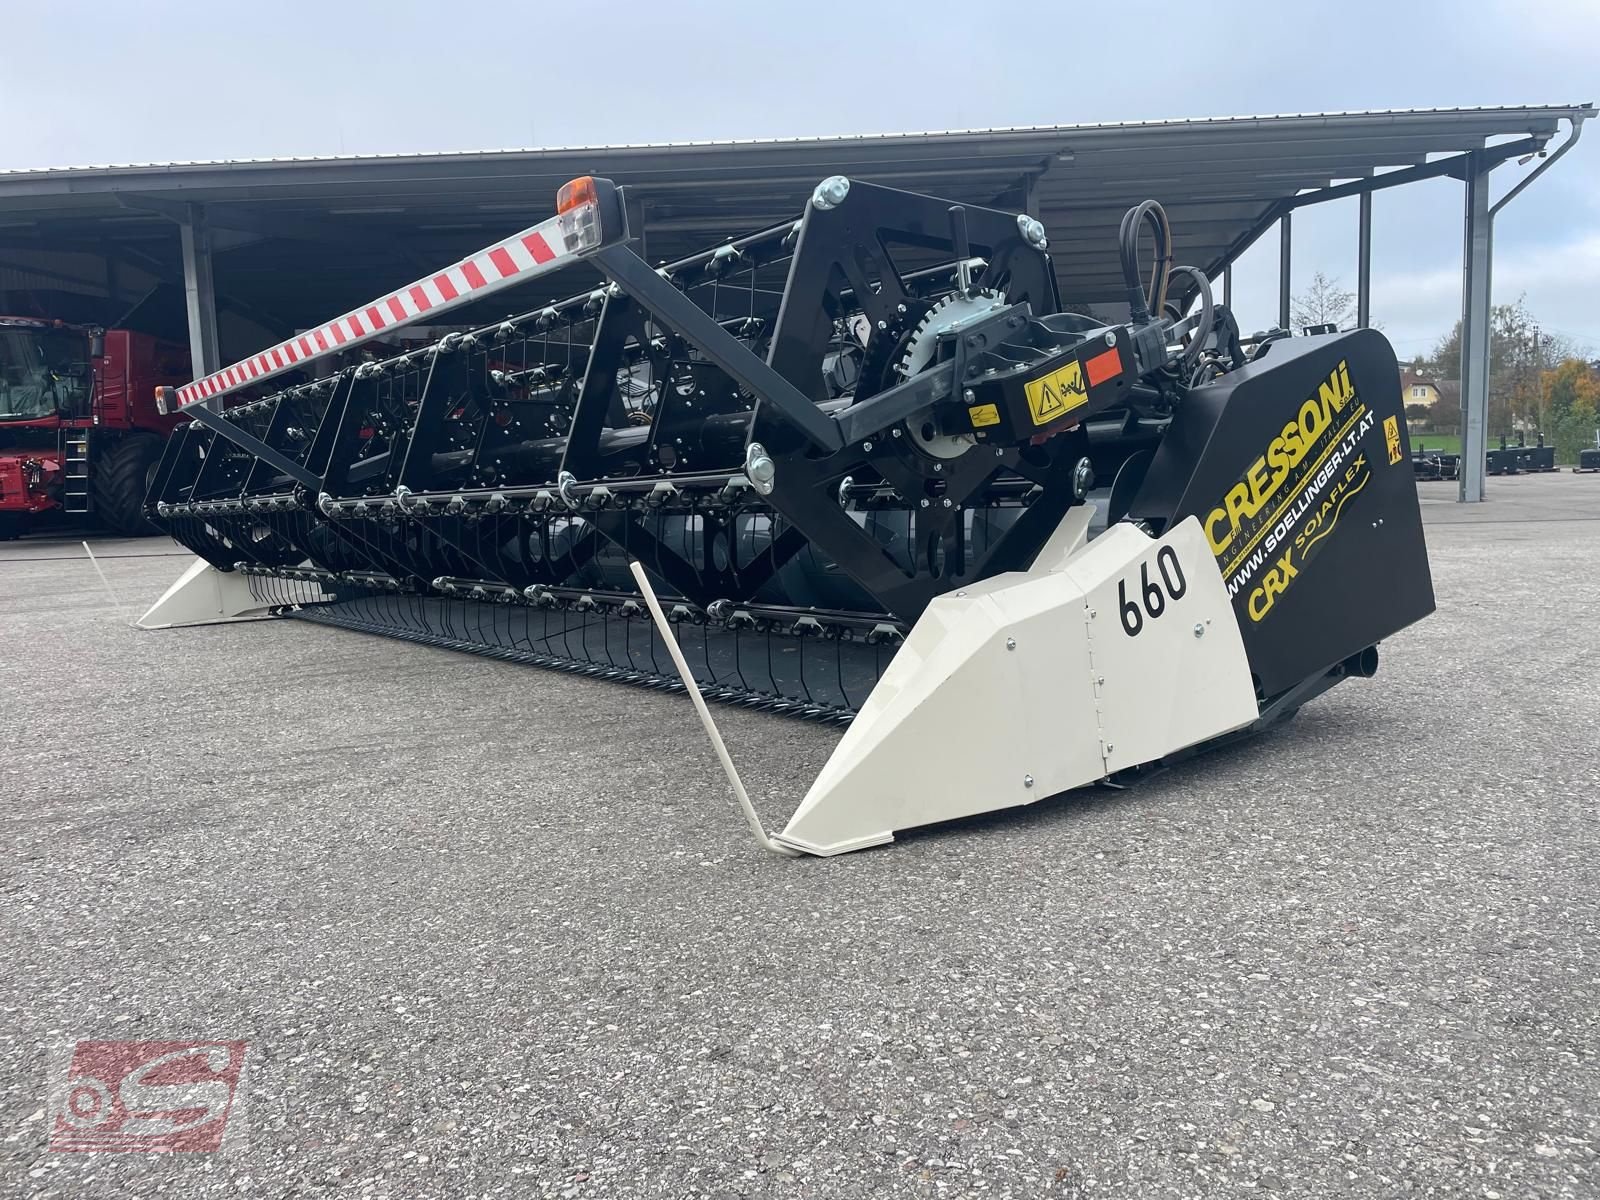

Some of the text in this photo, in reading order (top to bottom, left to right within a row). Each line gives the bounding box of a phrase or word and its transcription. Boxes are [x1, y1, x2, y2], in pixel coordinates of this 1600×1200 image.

[1222, 484, 1290, 565] NGINEERING
[1295, 453, 1367, 549] SOJAFLEX
[1117, 545, 1187, 637] 660
[1248, 546, 1299, 622] CRX
